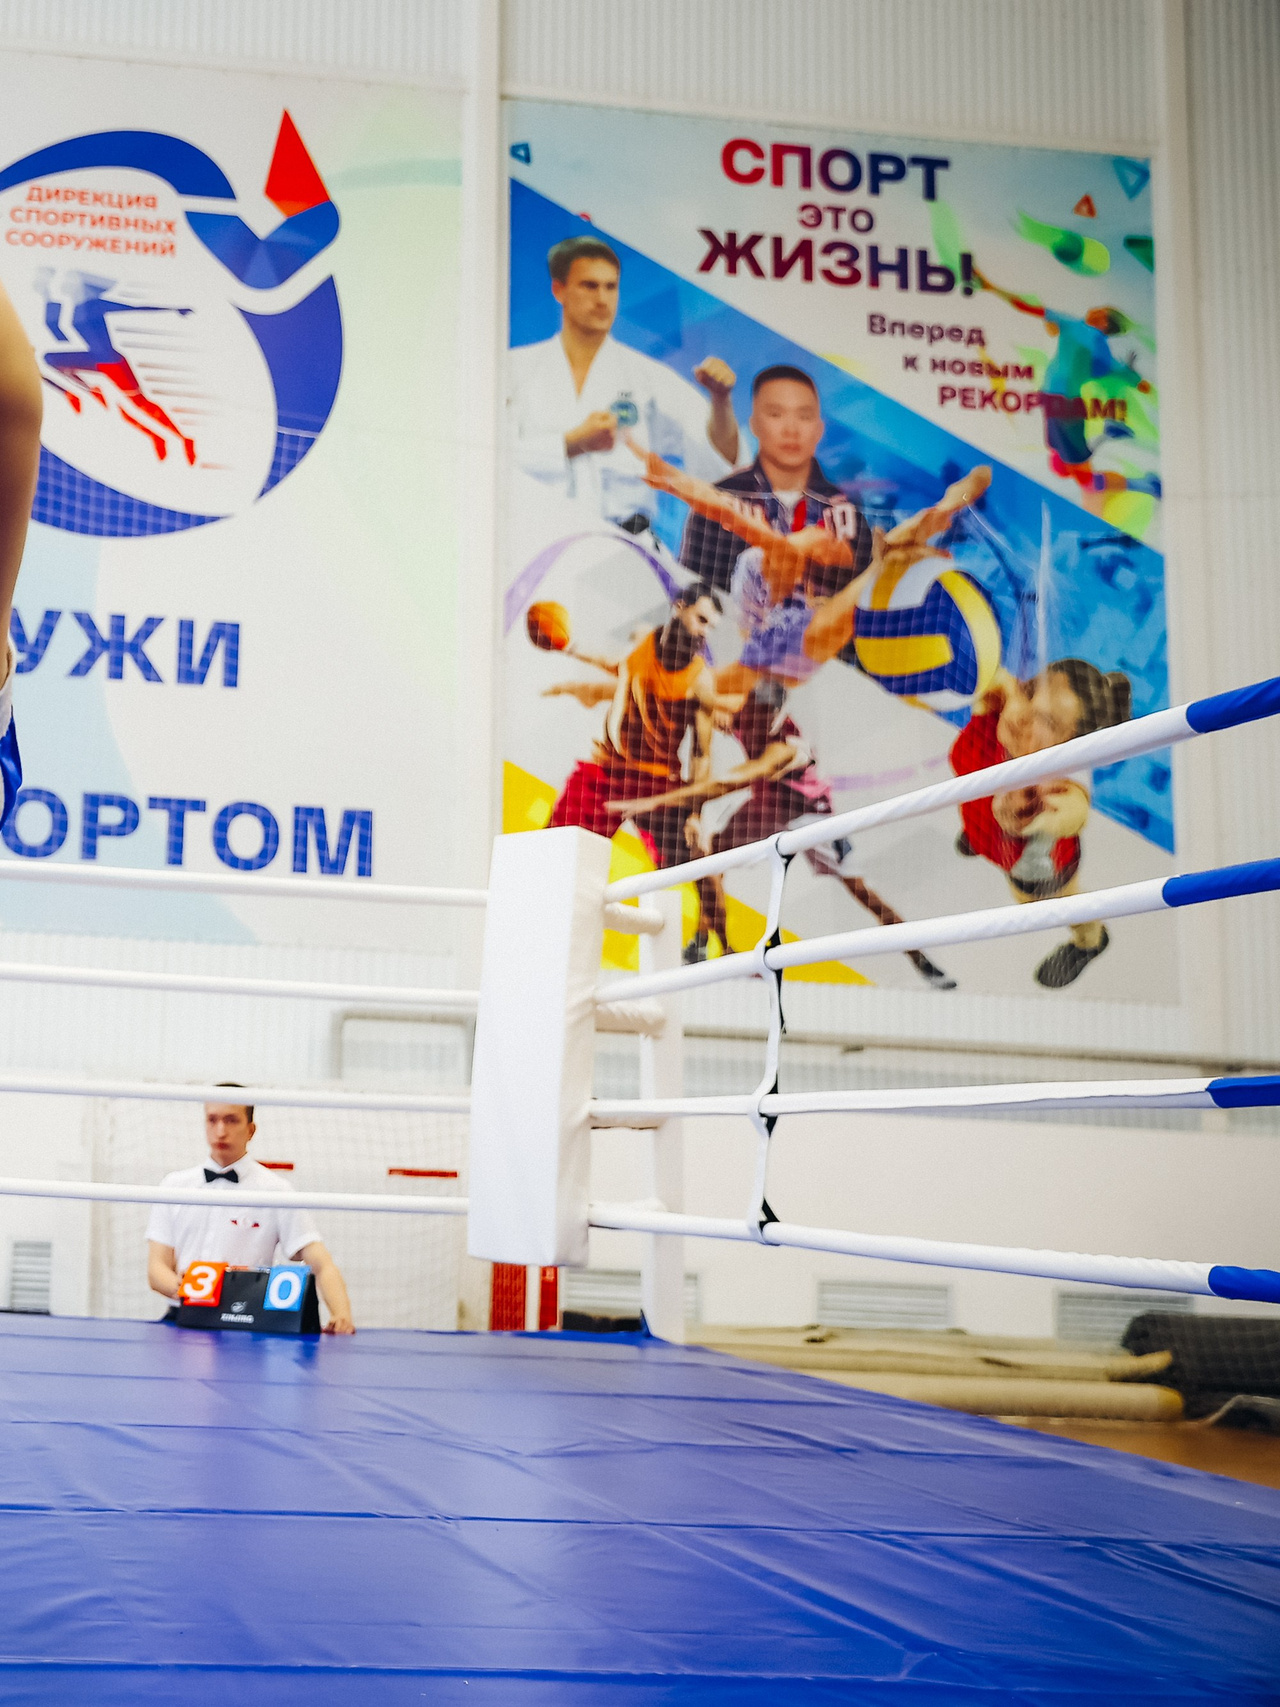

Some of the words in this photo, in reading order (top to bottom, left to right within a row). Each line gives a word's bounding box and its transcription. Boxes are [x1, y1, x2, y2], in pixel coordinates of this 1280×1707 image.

[721, 138, 950, 202] СПОРТ
[26, 186, 158, 210] ДИРЕКЦИЯ
[9, 206, 177, 235] СПОРТИВНЫХ
[5, 228, 177, 257] СООРУЖЕНИЙ
[696, 228, 974, 297] ЖИЗНЬ!
[868, 313, 986, 348] Вперед
[930, 357, 1034, 380] новым
[183, 1265, 217, 1298] 3
[269, 1271, 302, 1309] 0
